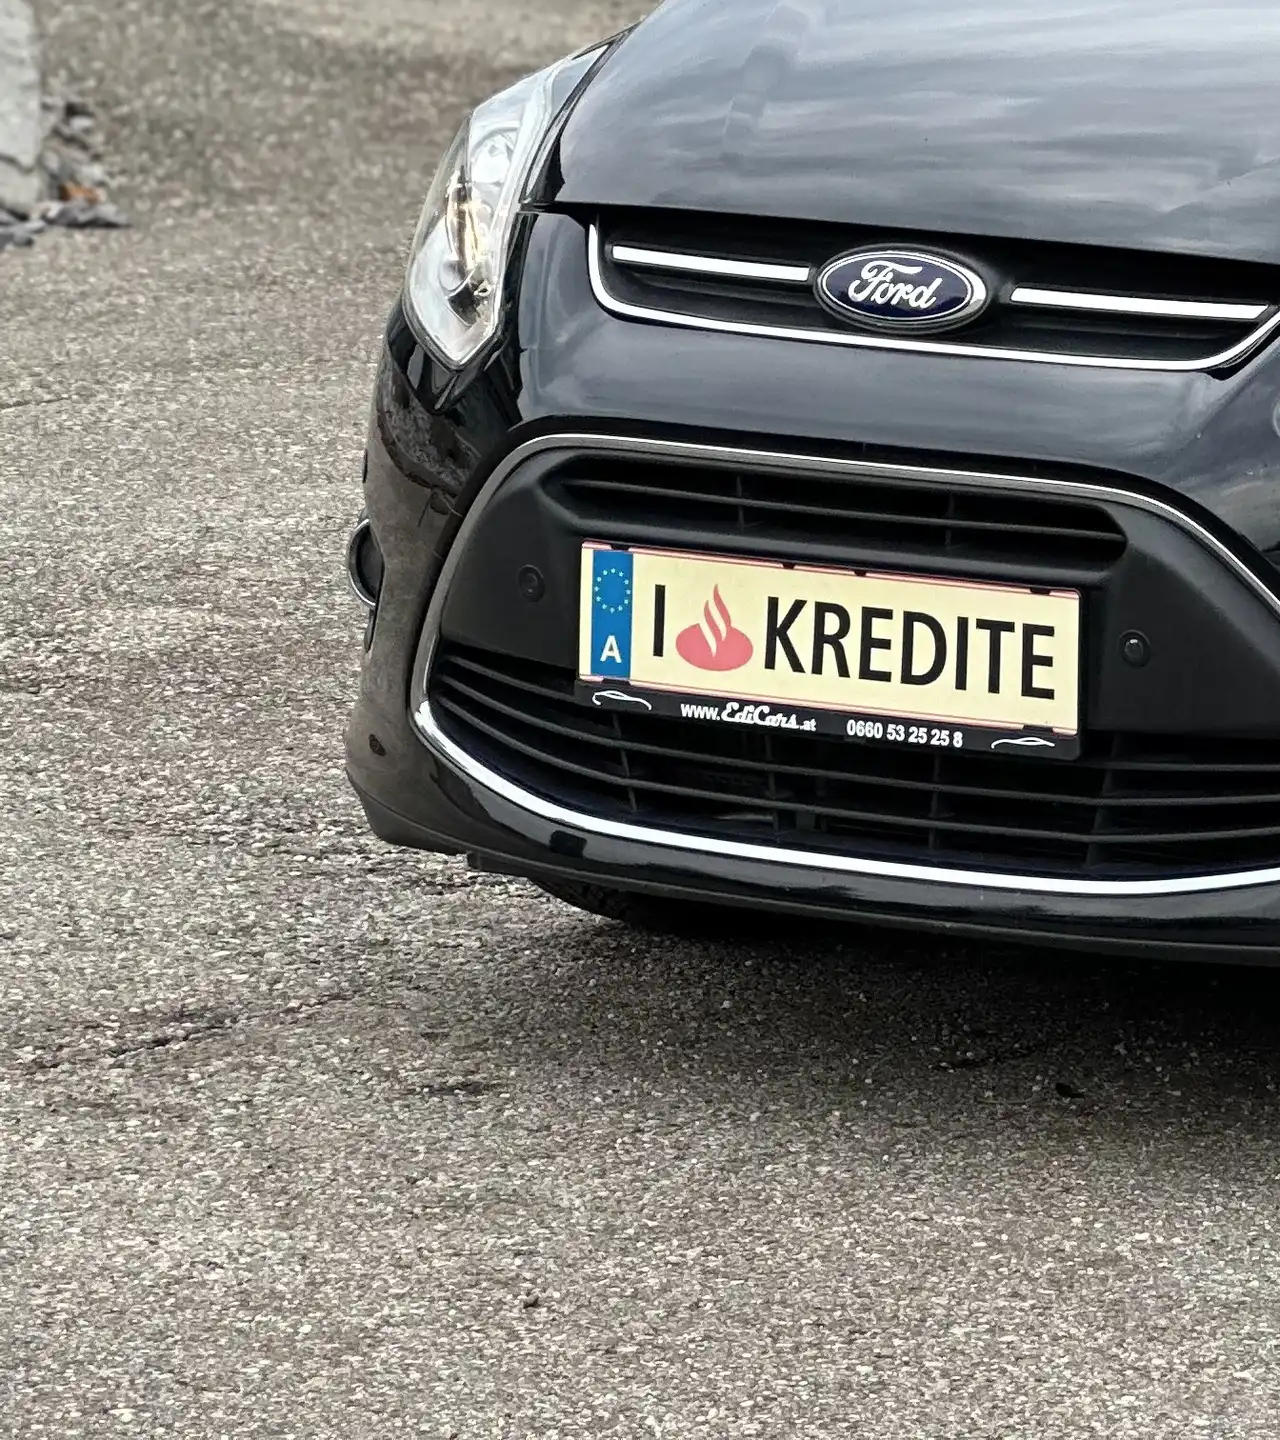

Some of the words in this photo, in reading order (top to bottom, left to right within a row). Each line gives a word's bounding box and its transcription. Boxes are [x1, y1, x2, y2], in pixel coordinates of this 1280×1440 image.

[847, 259, 943, 309] Ford
[600, 635, 623, 664] A
[652, 583, 666, 658] I
[764, 594, 1057, 700] KREDITE
[846, 718, 883, 739] 0660
[886, 723, 905, 742] 53
[908, 726, 928, 745] 25
